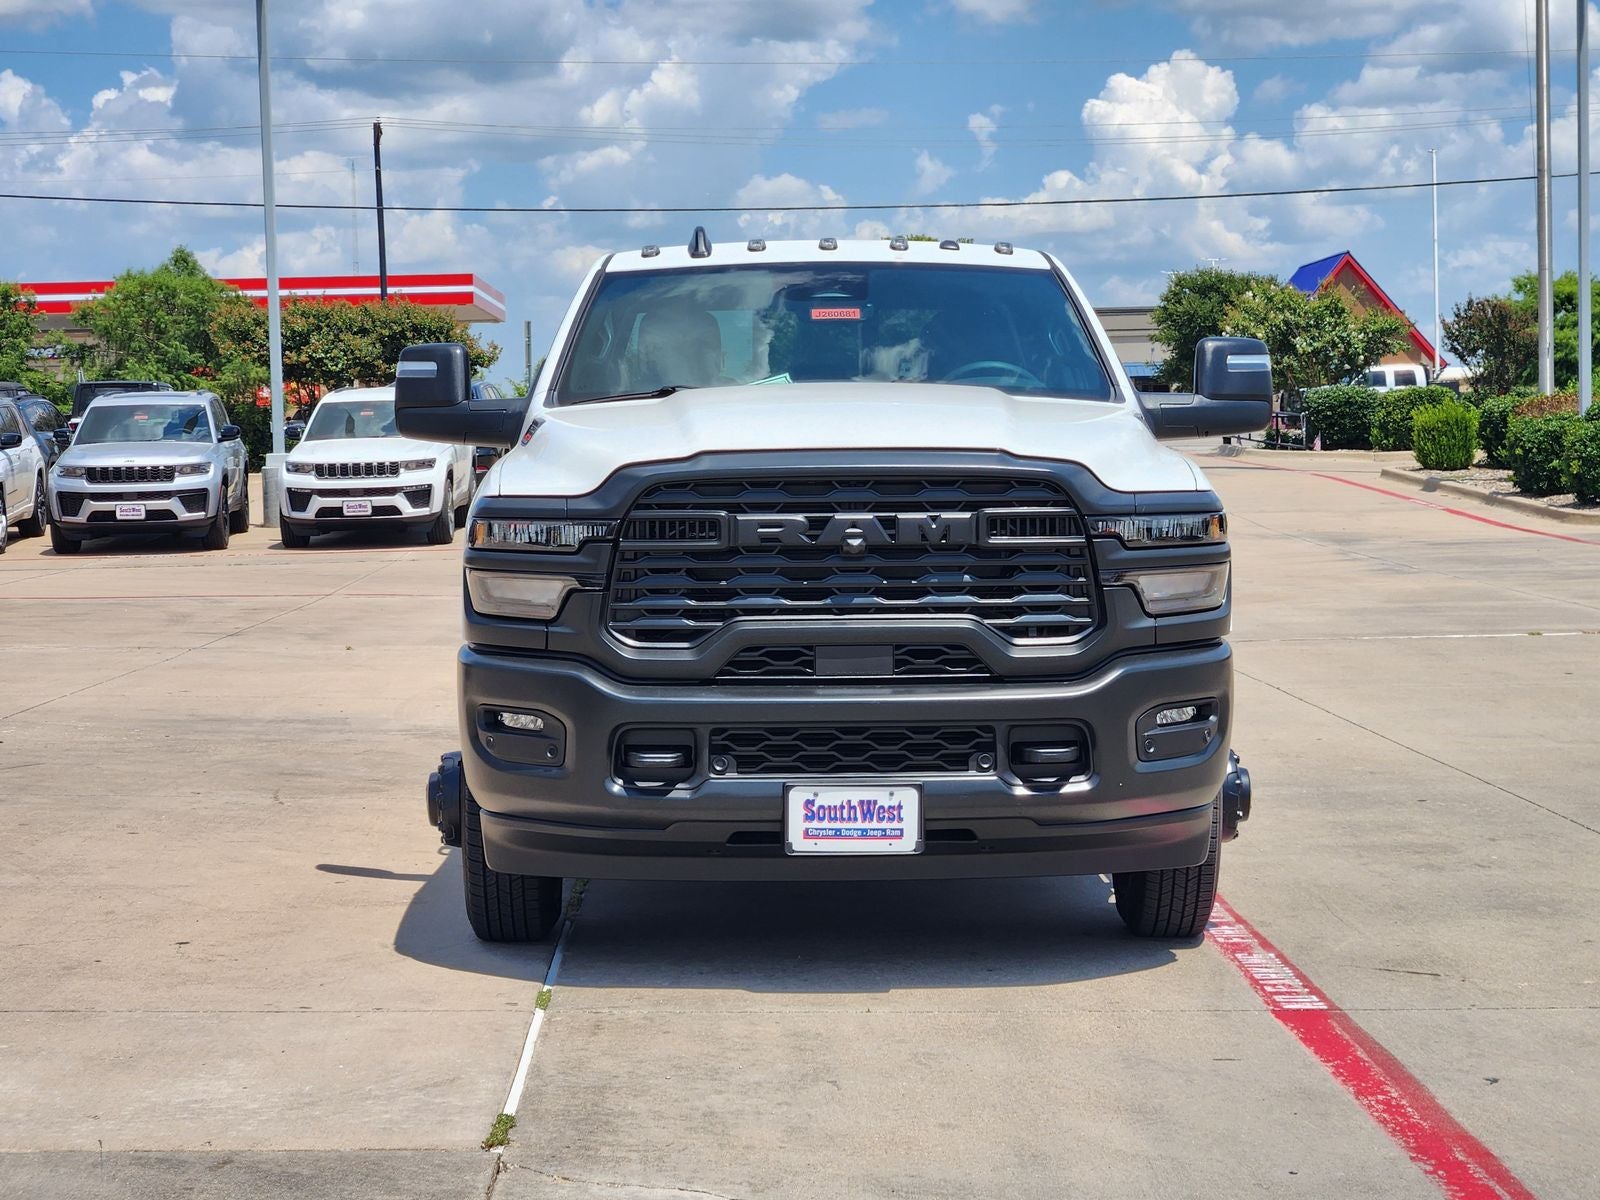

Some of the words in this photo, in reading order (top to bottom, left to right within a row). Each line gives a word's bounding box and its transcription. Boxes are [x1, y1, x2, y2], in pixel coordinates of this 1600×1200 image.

[736, 512, 972, 546] RAM
[803, 799, 904, 823] SouthWest
[808, 828, 835, 837] Chrysler
[841, 828, 862, 837] Dodge
[866, 828, 882, 838] Jeep
[886, 828, 901, 836] Ram
